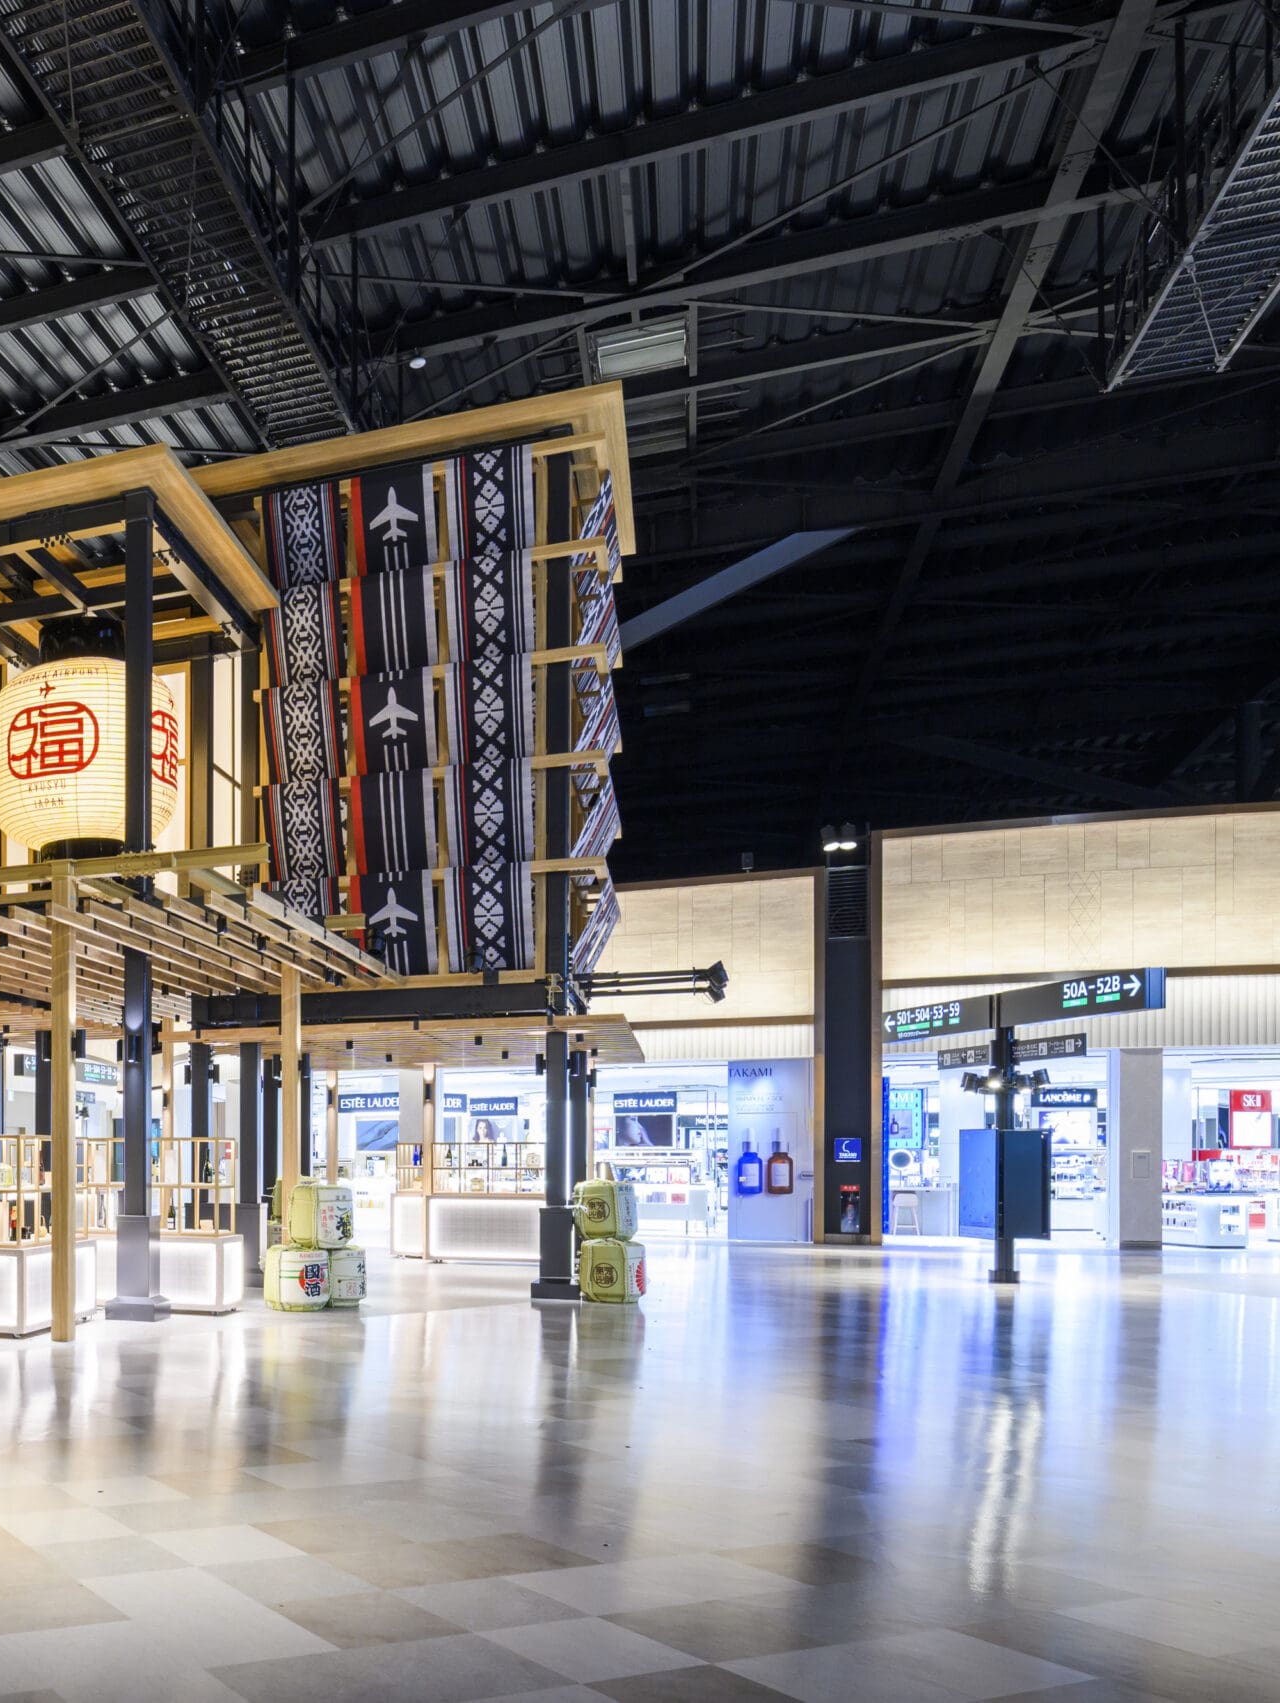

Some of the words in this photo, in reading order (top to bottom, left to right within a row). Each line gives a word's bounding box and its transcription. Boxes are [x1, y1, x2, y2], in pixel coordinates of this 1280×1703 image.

[728, 1067, 772, 1078] TAKAMI
[367, 1096, 400, 1108] LAUDE
[489, 1102, 515, 1111] LAUDER
[640, 1098, 674, 1108] LAUDER
